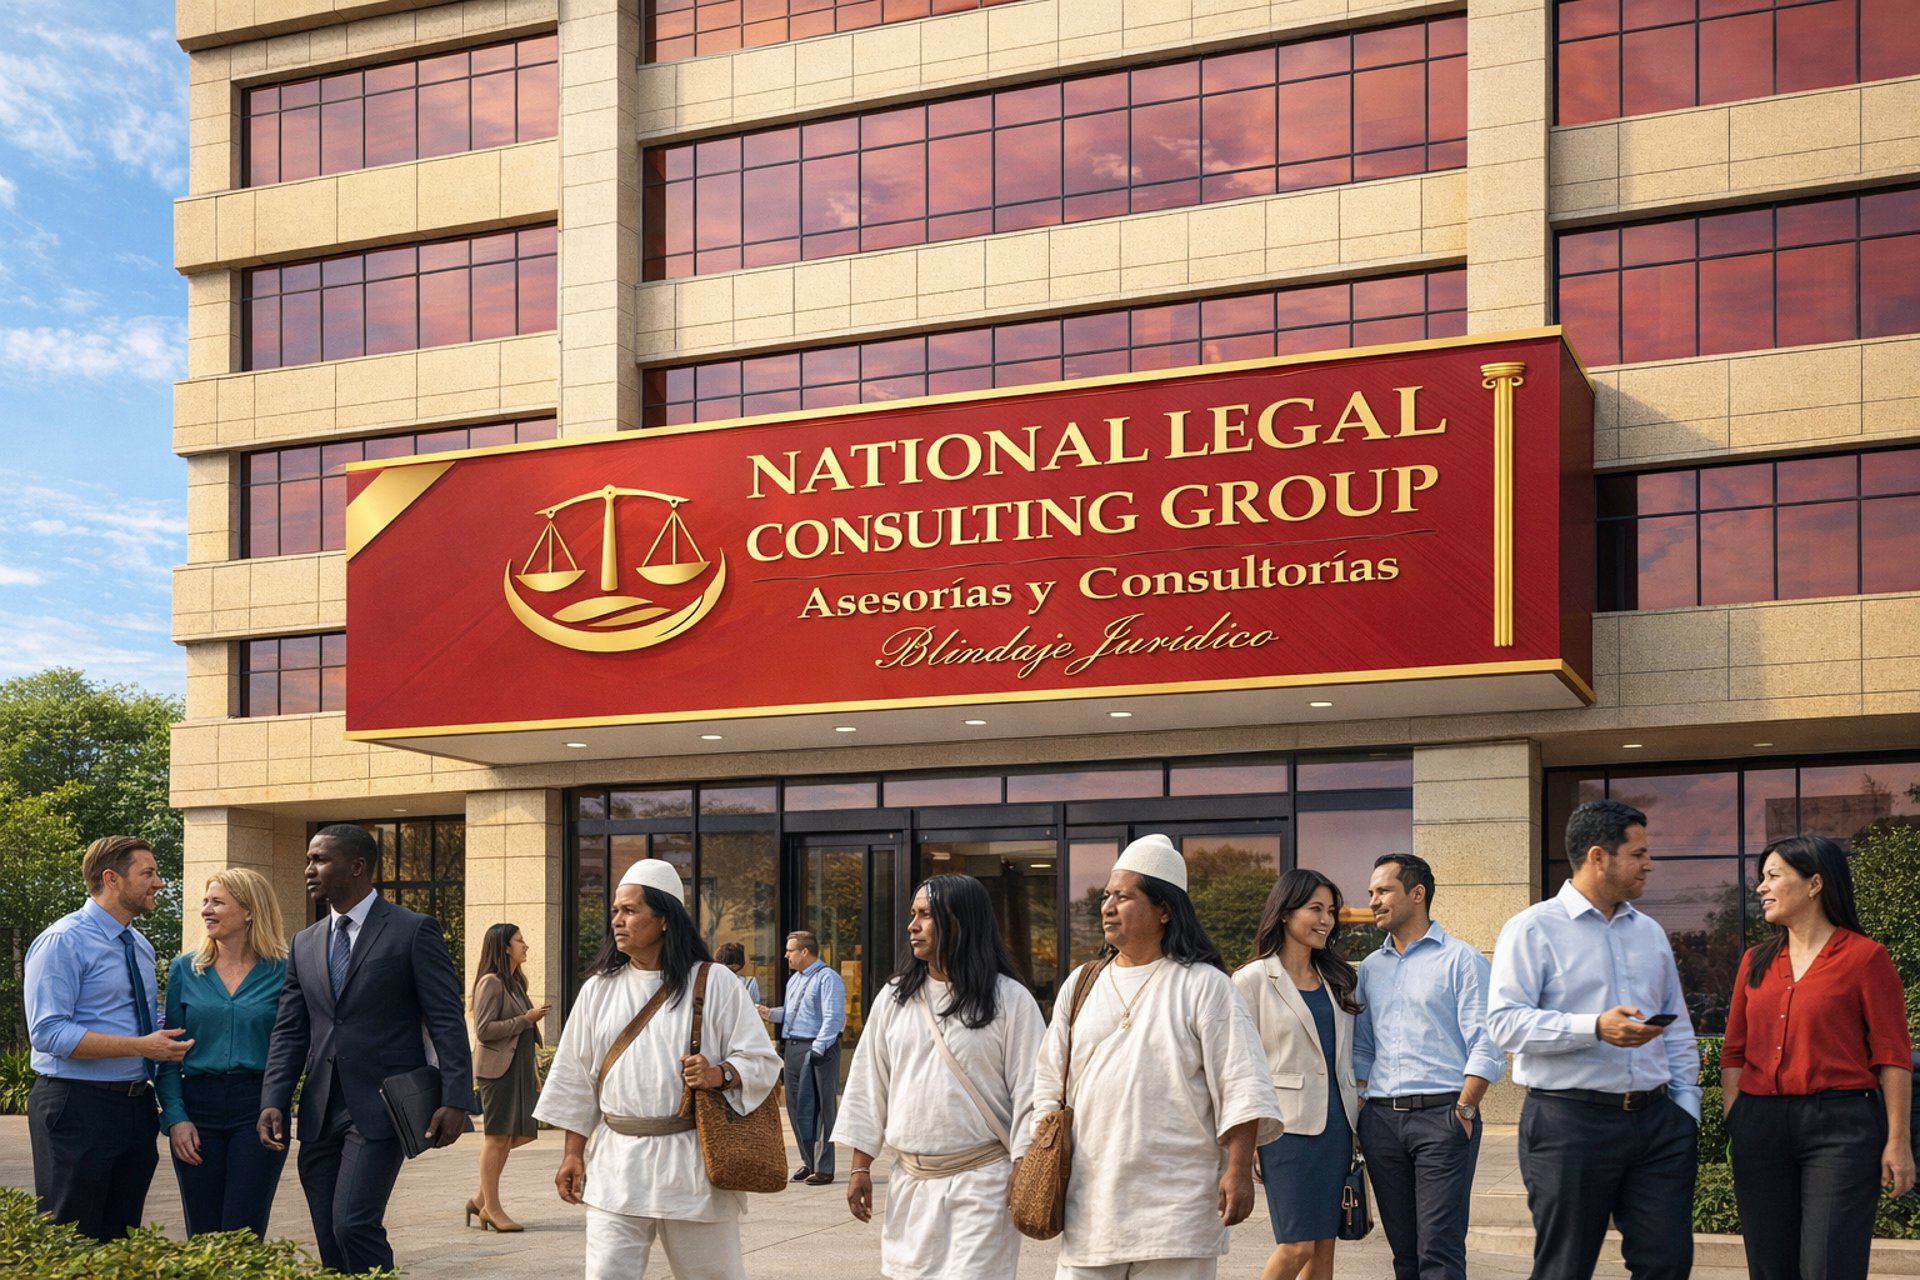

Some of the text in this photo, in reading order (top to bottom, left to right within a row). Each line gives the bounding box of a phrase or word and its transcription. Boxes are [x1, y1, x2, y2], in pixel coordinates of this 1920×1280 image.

[746, 385, 1448, 499] NATIONAL LEGAL
[746, 464, 1439, 562] CONSULTING GROUP
[798, 552, 1400, 619] Asesorías y Consultorías
[874, 611, 1279, 680] Blindaje Jurídico
